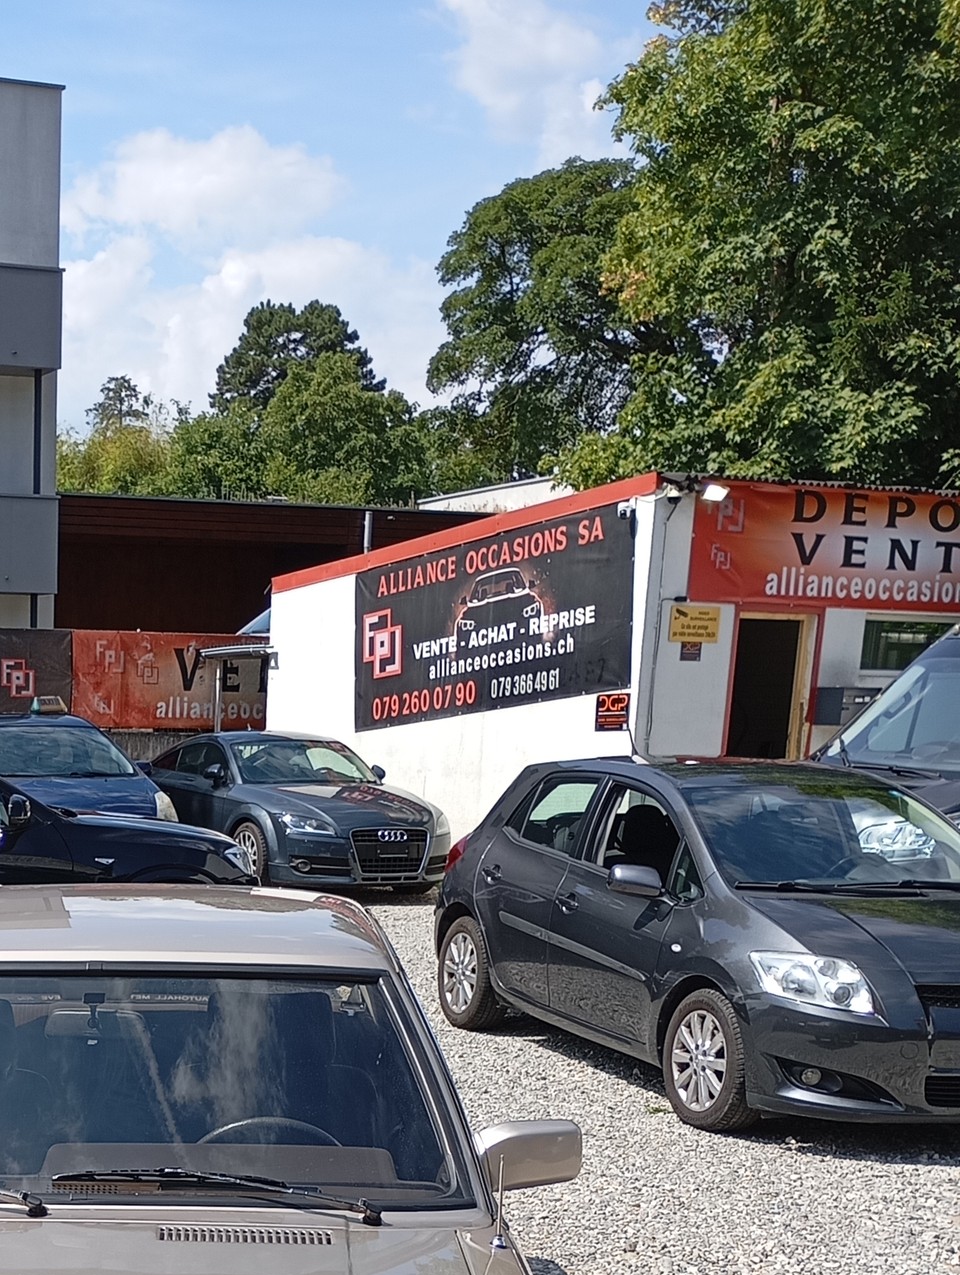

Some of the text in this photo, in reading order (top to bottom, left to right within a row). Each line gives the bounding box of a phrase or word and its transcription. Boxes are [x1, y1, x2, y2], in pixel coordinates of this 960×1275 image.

[377, 516, 604, 598] ALLIANCE OCCASIONS SA
[791, 532, 960, 574] VENT
[413, 635, 458, 660] VENTE
[468, 621, 517, 649] ACHAT
[529, 604, 596, 636] REPRISE
[429, 633, 574, 680] allianceoccasions.ch
